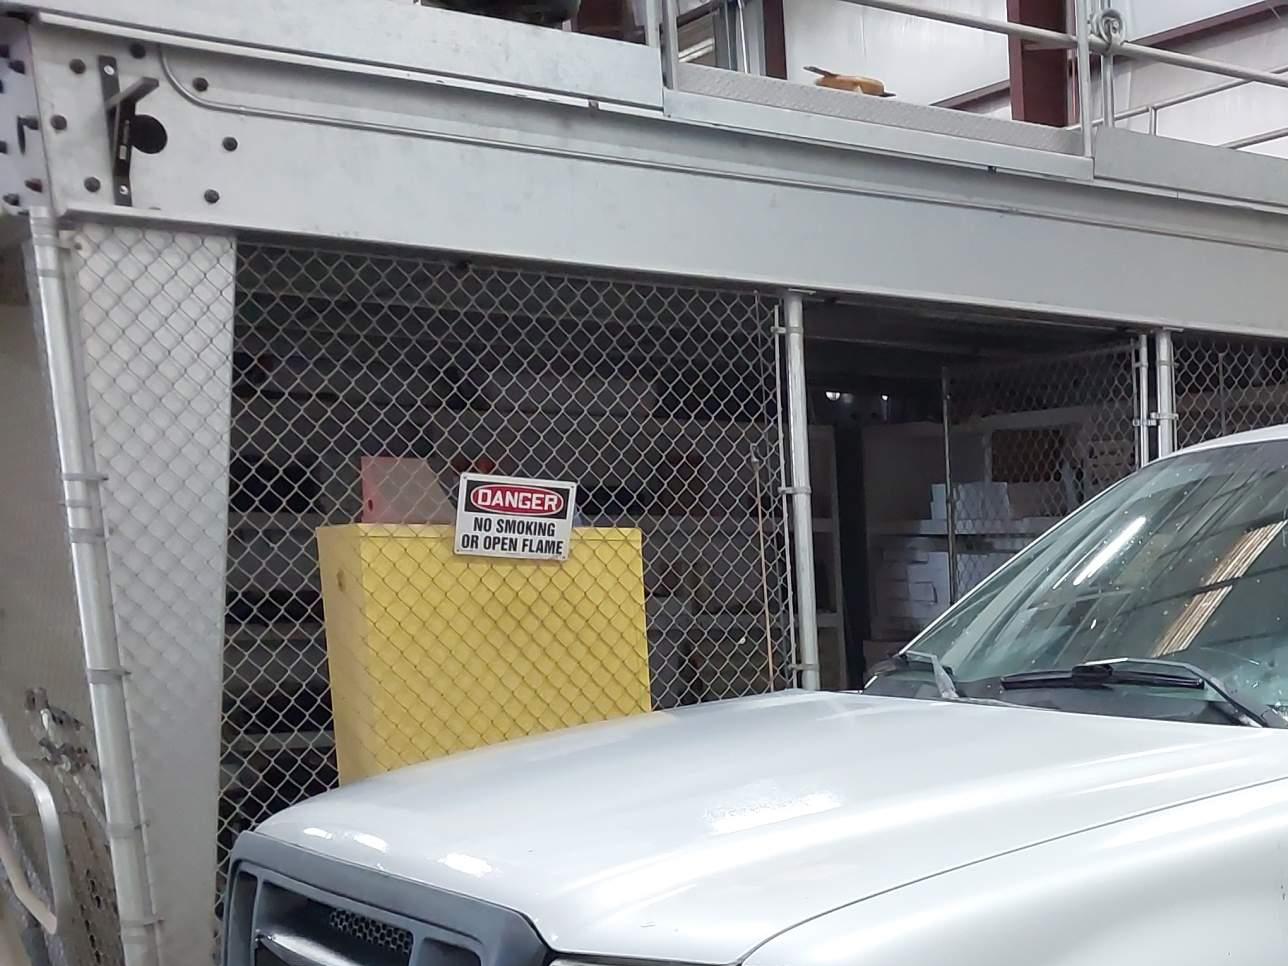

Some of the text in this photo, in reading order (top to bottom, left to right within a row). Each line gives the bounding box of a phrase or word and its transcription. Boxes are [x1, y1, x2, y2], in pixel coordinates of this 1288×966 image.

[477, 488, 558, 511] DANGER
[473, 517, 556, 537] NO SMOKING
[461, 534, 564, 555] OR OPEN FLAME
